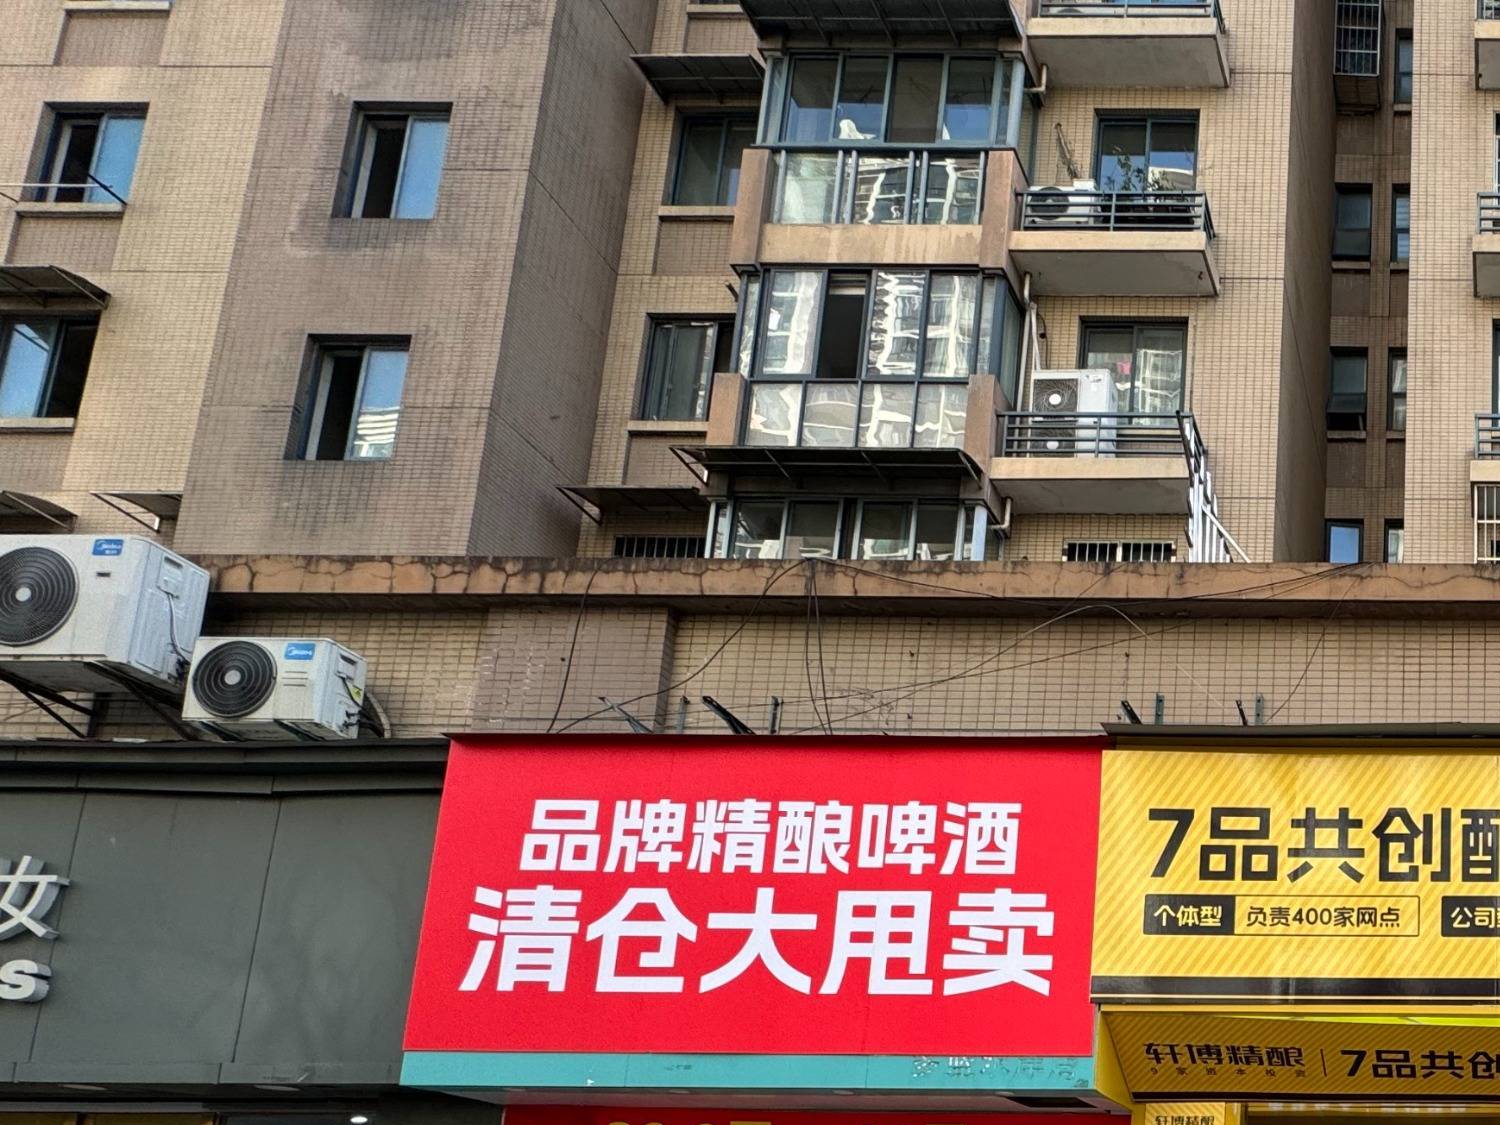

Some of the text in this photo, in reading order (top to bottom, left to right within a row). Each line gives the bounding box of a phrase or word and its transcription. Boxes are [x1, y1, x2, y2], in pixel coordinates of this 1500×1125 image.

[519, 799, 1022, 876] 品牌精酿啤酒
[459, 885, 1055, 998] 清仓大甩卖
[1153, 904, 1401, 928] 个体型 负责400家网点
[1143, 1042, 1305, 1067] 轩博精酿
